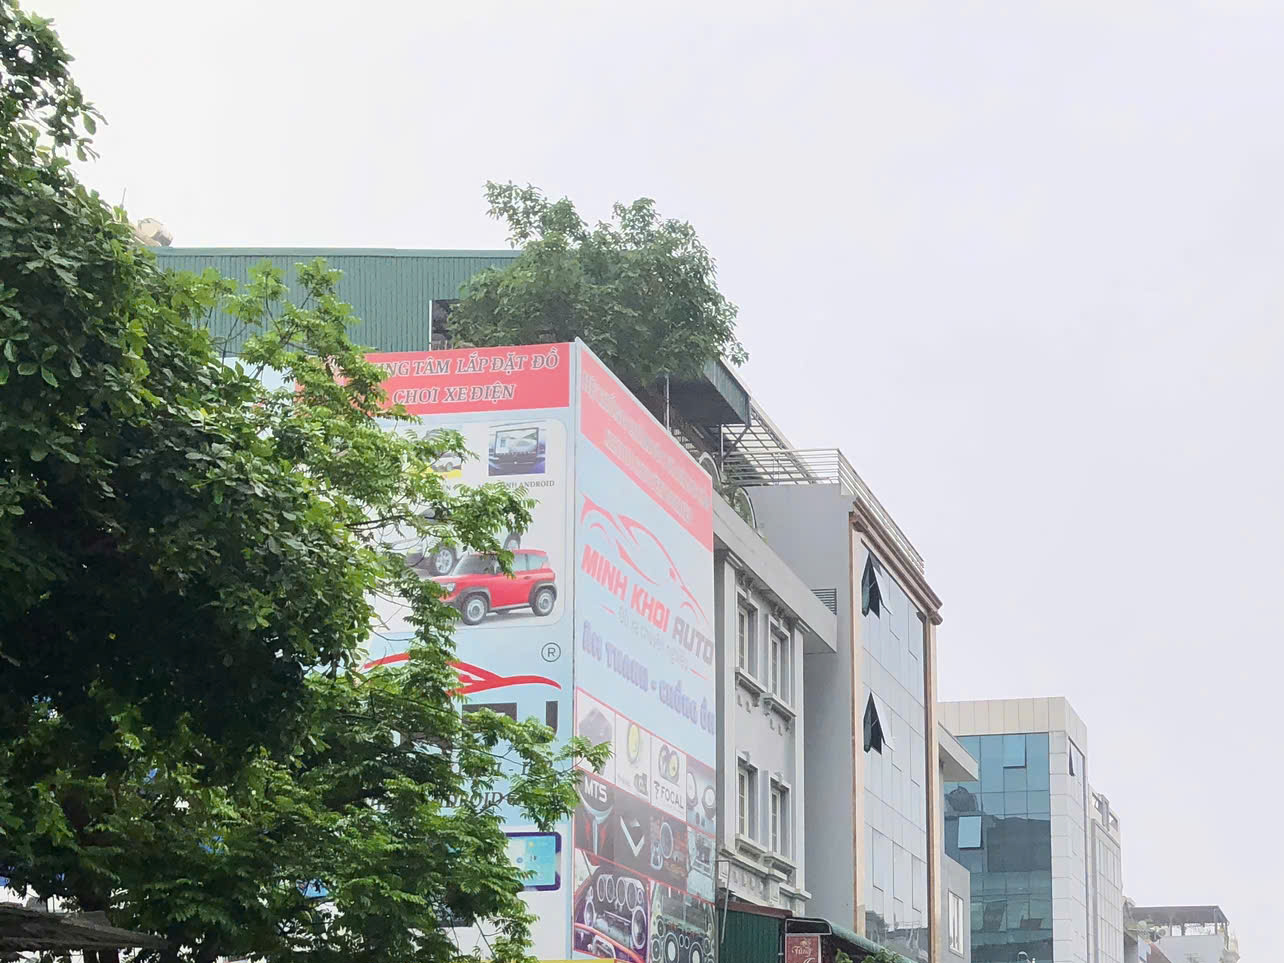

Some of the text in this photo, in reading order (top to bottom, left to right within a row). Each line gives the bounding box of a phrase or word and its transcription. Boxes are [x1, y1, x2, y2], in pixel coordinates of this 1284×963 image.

[413, 356, 452, 376] TÂM
[456, 351, 491, 374] LẮP
[491, 354, 528, 374] ĐẶT
[532, 346, 560, 370] ĐỒ
[392, 382, 517, 404] CHƠI XE ĐIỆN
[582, 543, 629, 601] MINH
[672, 616, 714, 666] AUTO
[584, 775, 608, 803] MTS
[660, 784, 685, 809] FOCAL
